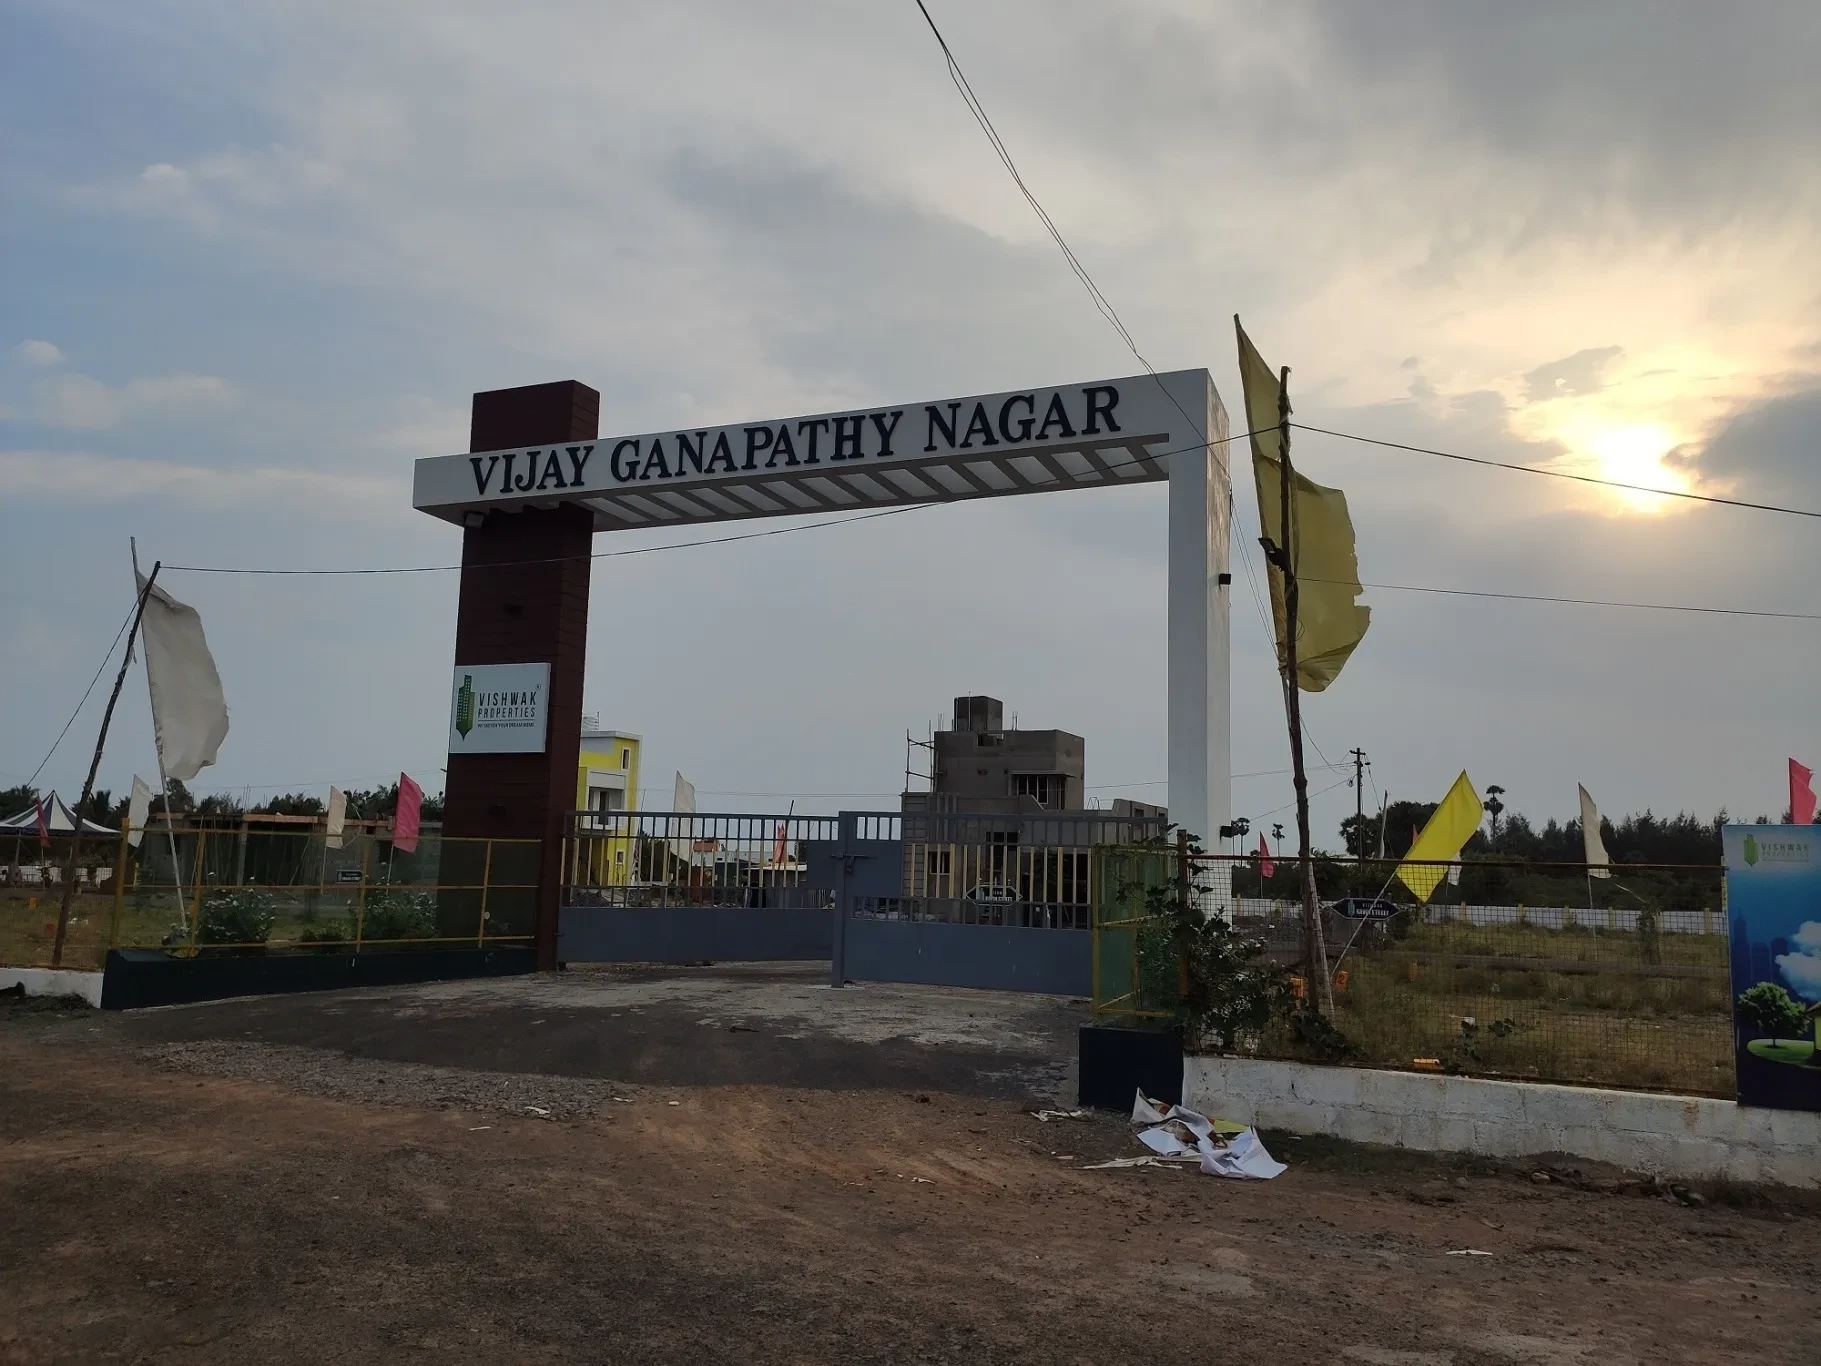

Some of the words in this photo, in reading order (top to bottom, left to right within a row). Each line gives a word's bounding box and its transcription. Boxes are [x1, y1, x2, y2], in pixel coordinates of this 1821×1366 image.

[469, 445, 595, 495] VIJAY
[610, 410, 904, 483] GANAPATHY
[923, 385, 1122, 452] NAGAR
[479, 691, 537, 706] VISHWAK
[477, 707, 536, 719] PROPERTIES
